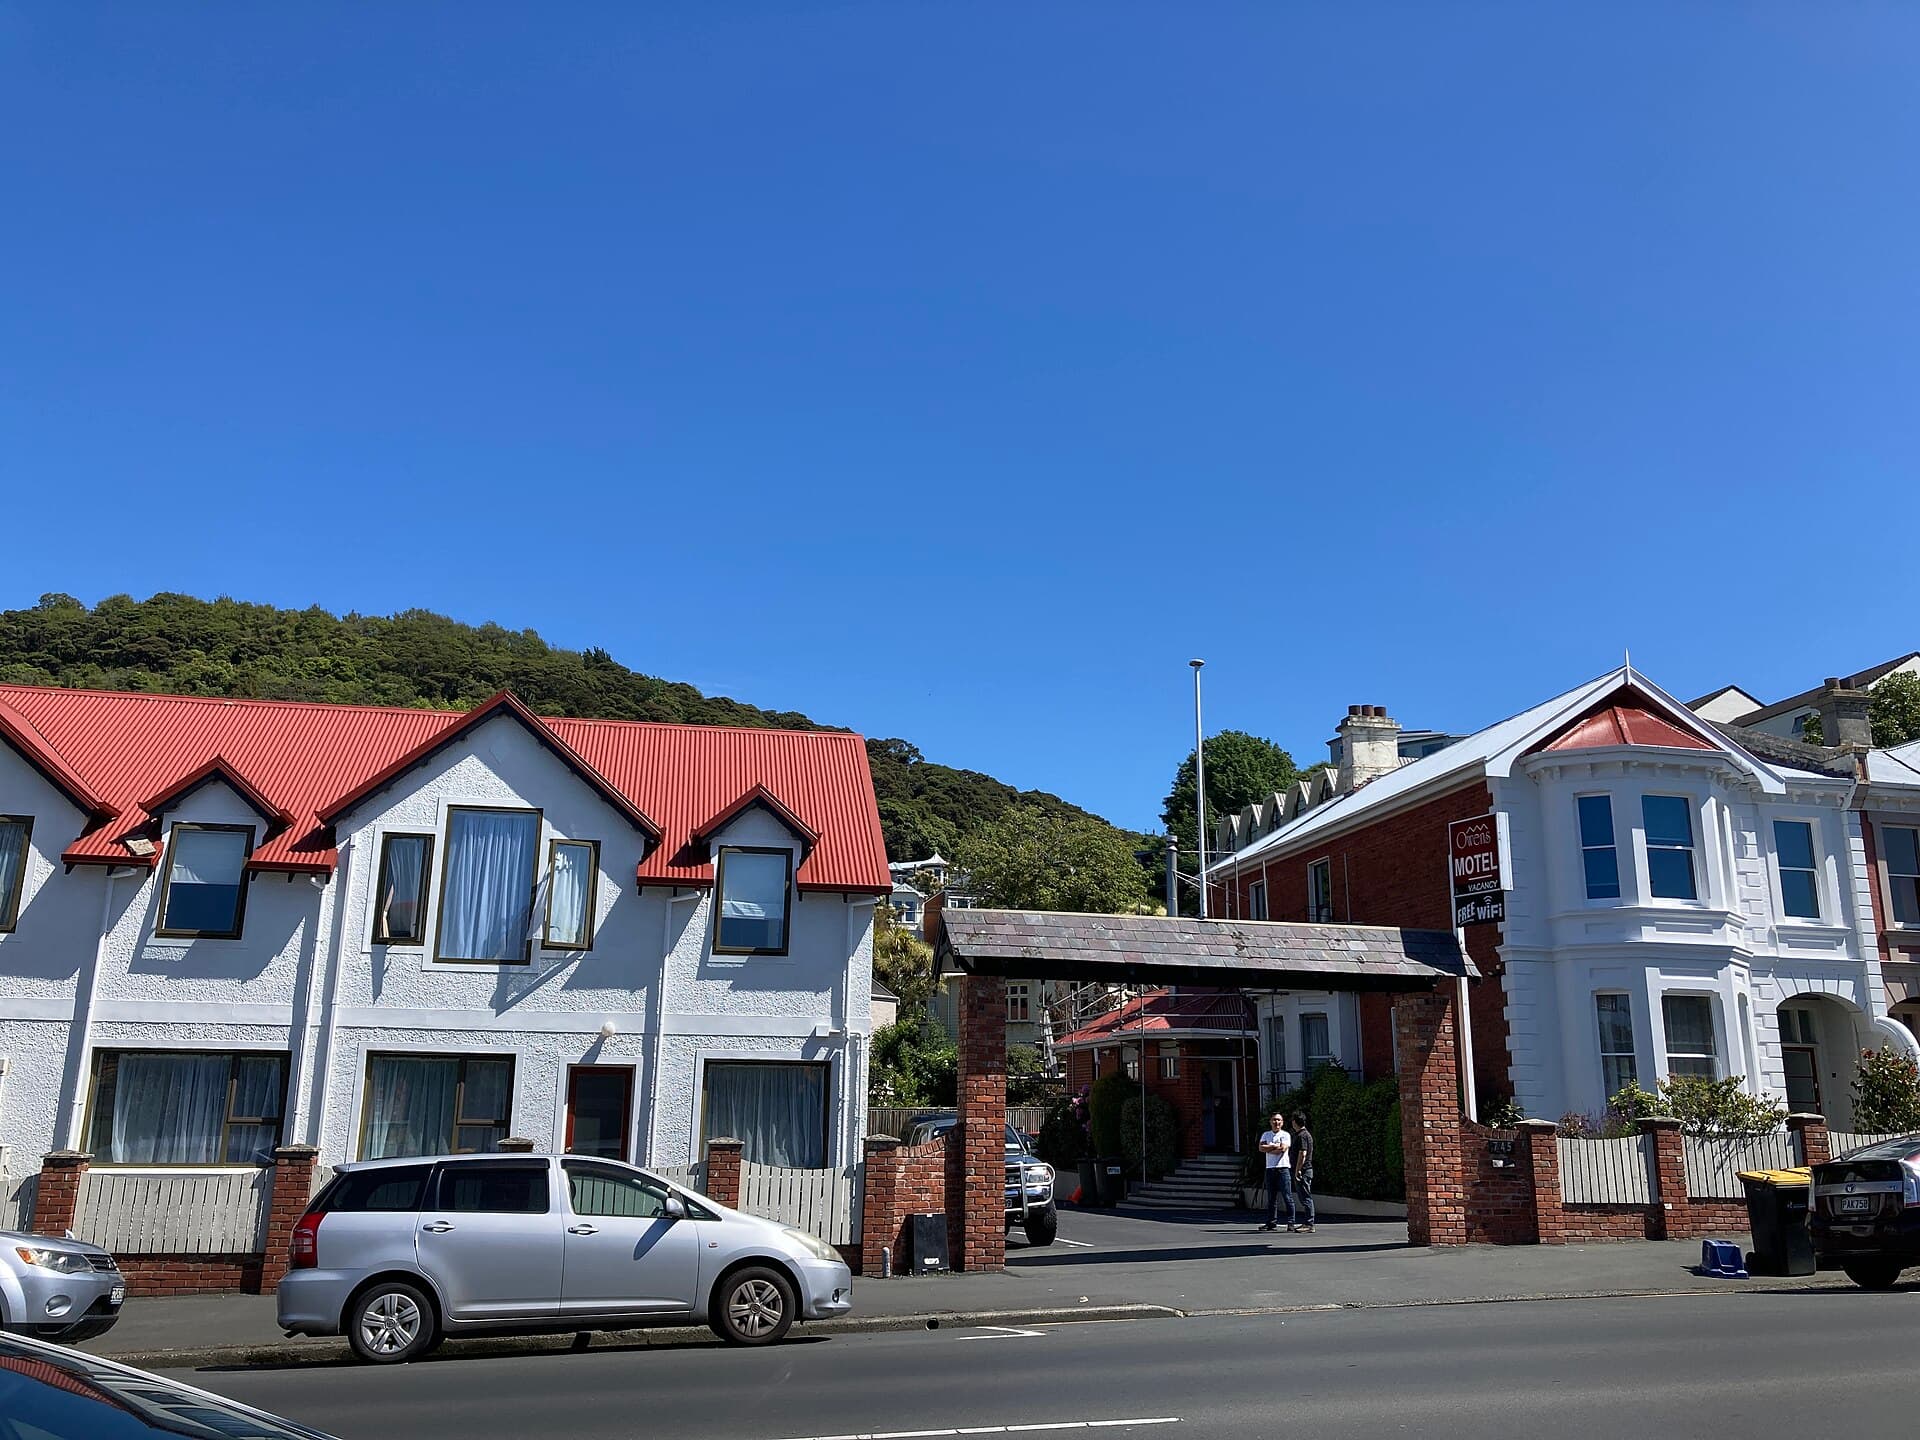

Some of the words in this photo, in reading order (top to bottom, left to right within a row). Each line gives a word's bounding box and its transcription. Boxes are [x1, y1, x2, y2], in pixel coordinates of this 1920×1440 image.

[1456, 831, 1491, 849] Owens
[1454, 851, 1498, 877] MOTEL
[1468, 880, 1498, 892] VACANCY
[1457, 901, 1475, 924] FREE
[1476, 903, 1503, 920] WiFi
